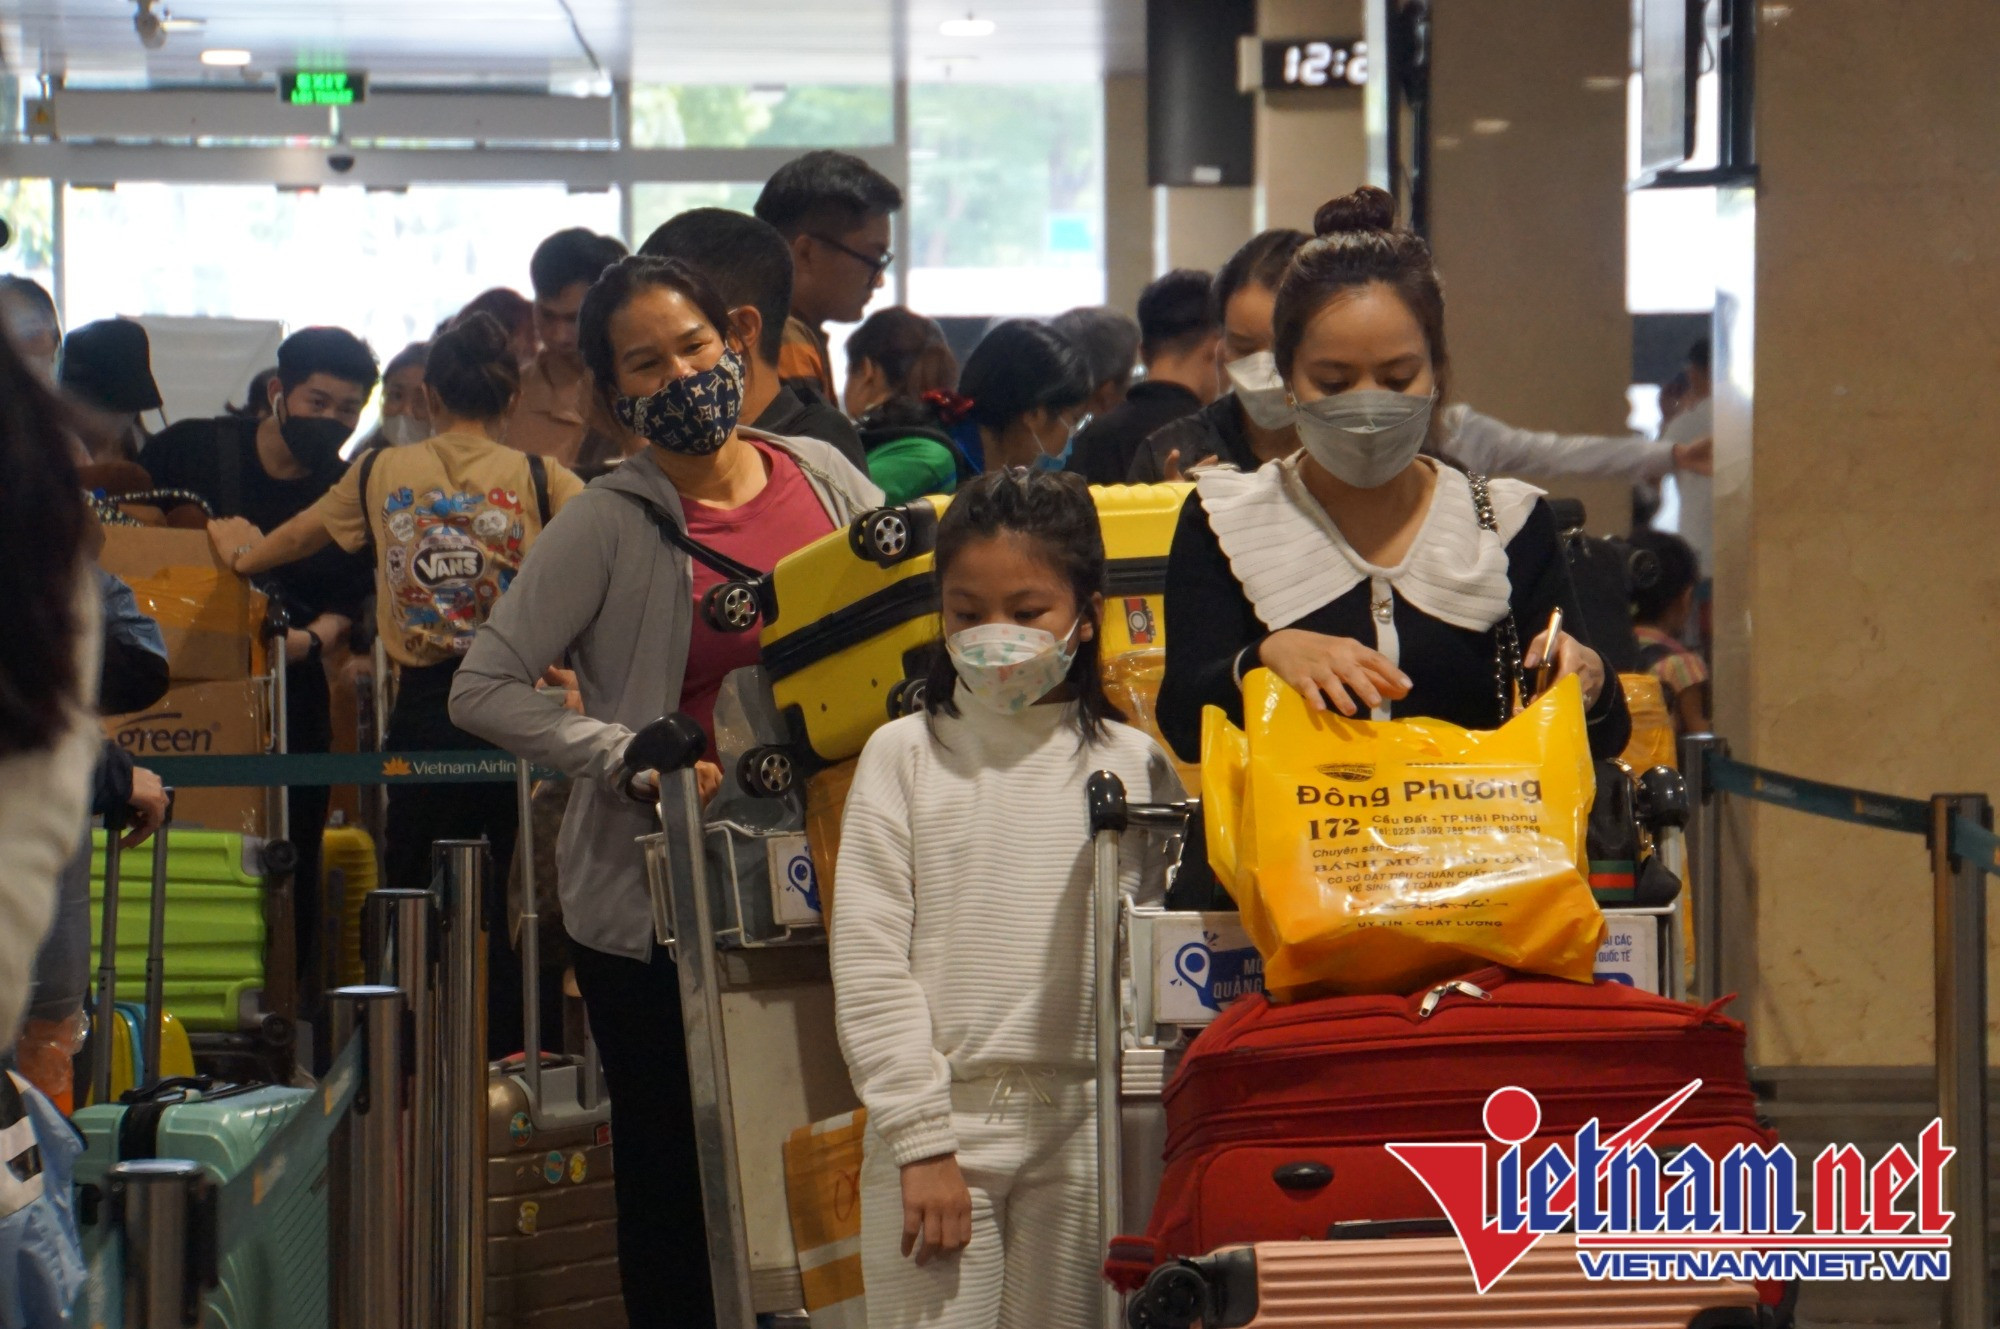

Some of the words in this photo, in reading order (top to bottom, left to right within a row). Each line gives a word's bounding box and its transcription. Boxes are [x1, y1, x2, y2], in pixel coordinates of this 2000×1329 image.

[417, 551, 478, 580] VANS
[412, 761, 476, 775] Vietnam
[477, 760, 534, 774] Airlins
[1296, 785, 1390, 808] Đông
[1403, 779, 1542, 804] Phương
[1308, 818, 1361, 840] 172
[1313, 846, 1358, 858] Chuyên
